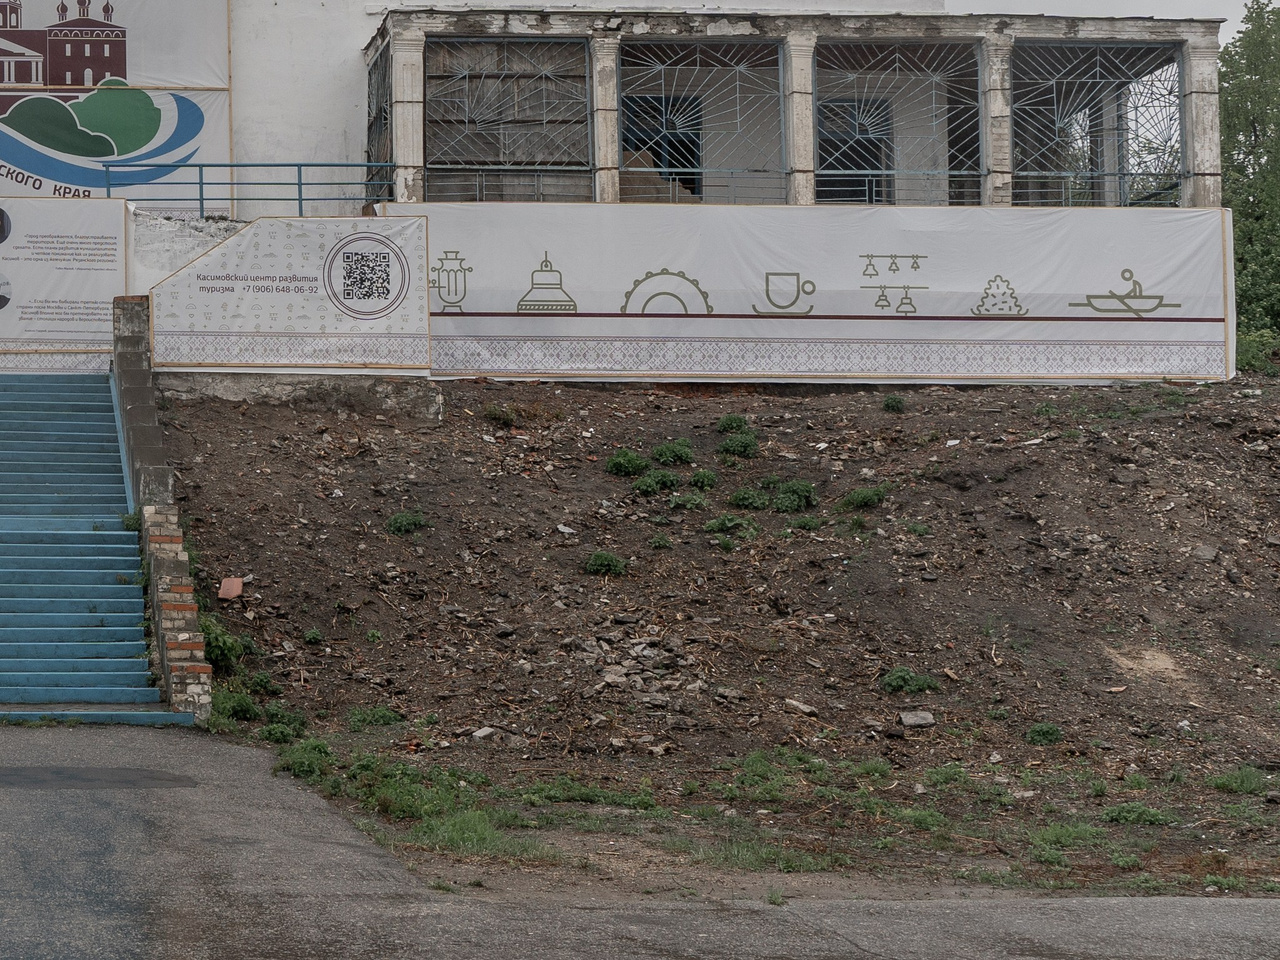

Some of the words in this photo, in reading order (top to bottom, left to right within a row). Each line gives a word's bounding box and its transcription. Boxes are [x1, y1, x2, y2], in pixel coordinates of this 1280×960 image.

[52, 184, 91, 198] КРАЯ
[196, 273, 249, 283] Касимовский
[249, 276, 277, 284] центр
[278, 274, 319, 285] развития
[199, 286, 236, 294] туризма
[242, 285, 251, 293] +7
[252, 284, 274, 294] (906)
[275, 285, 319, 294] 648-06-92
